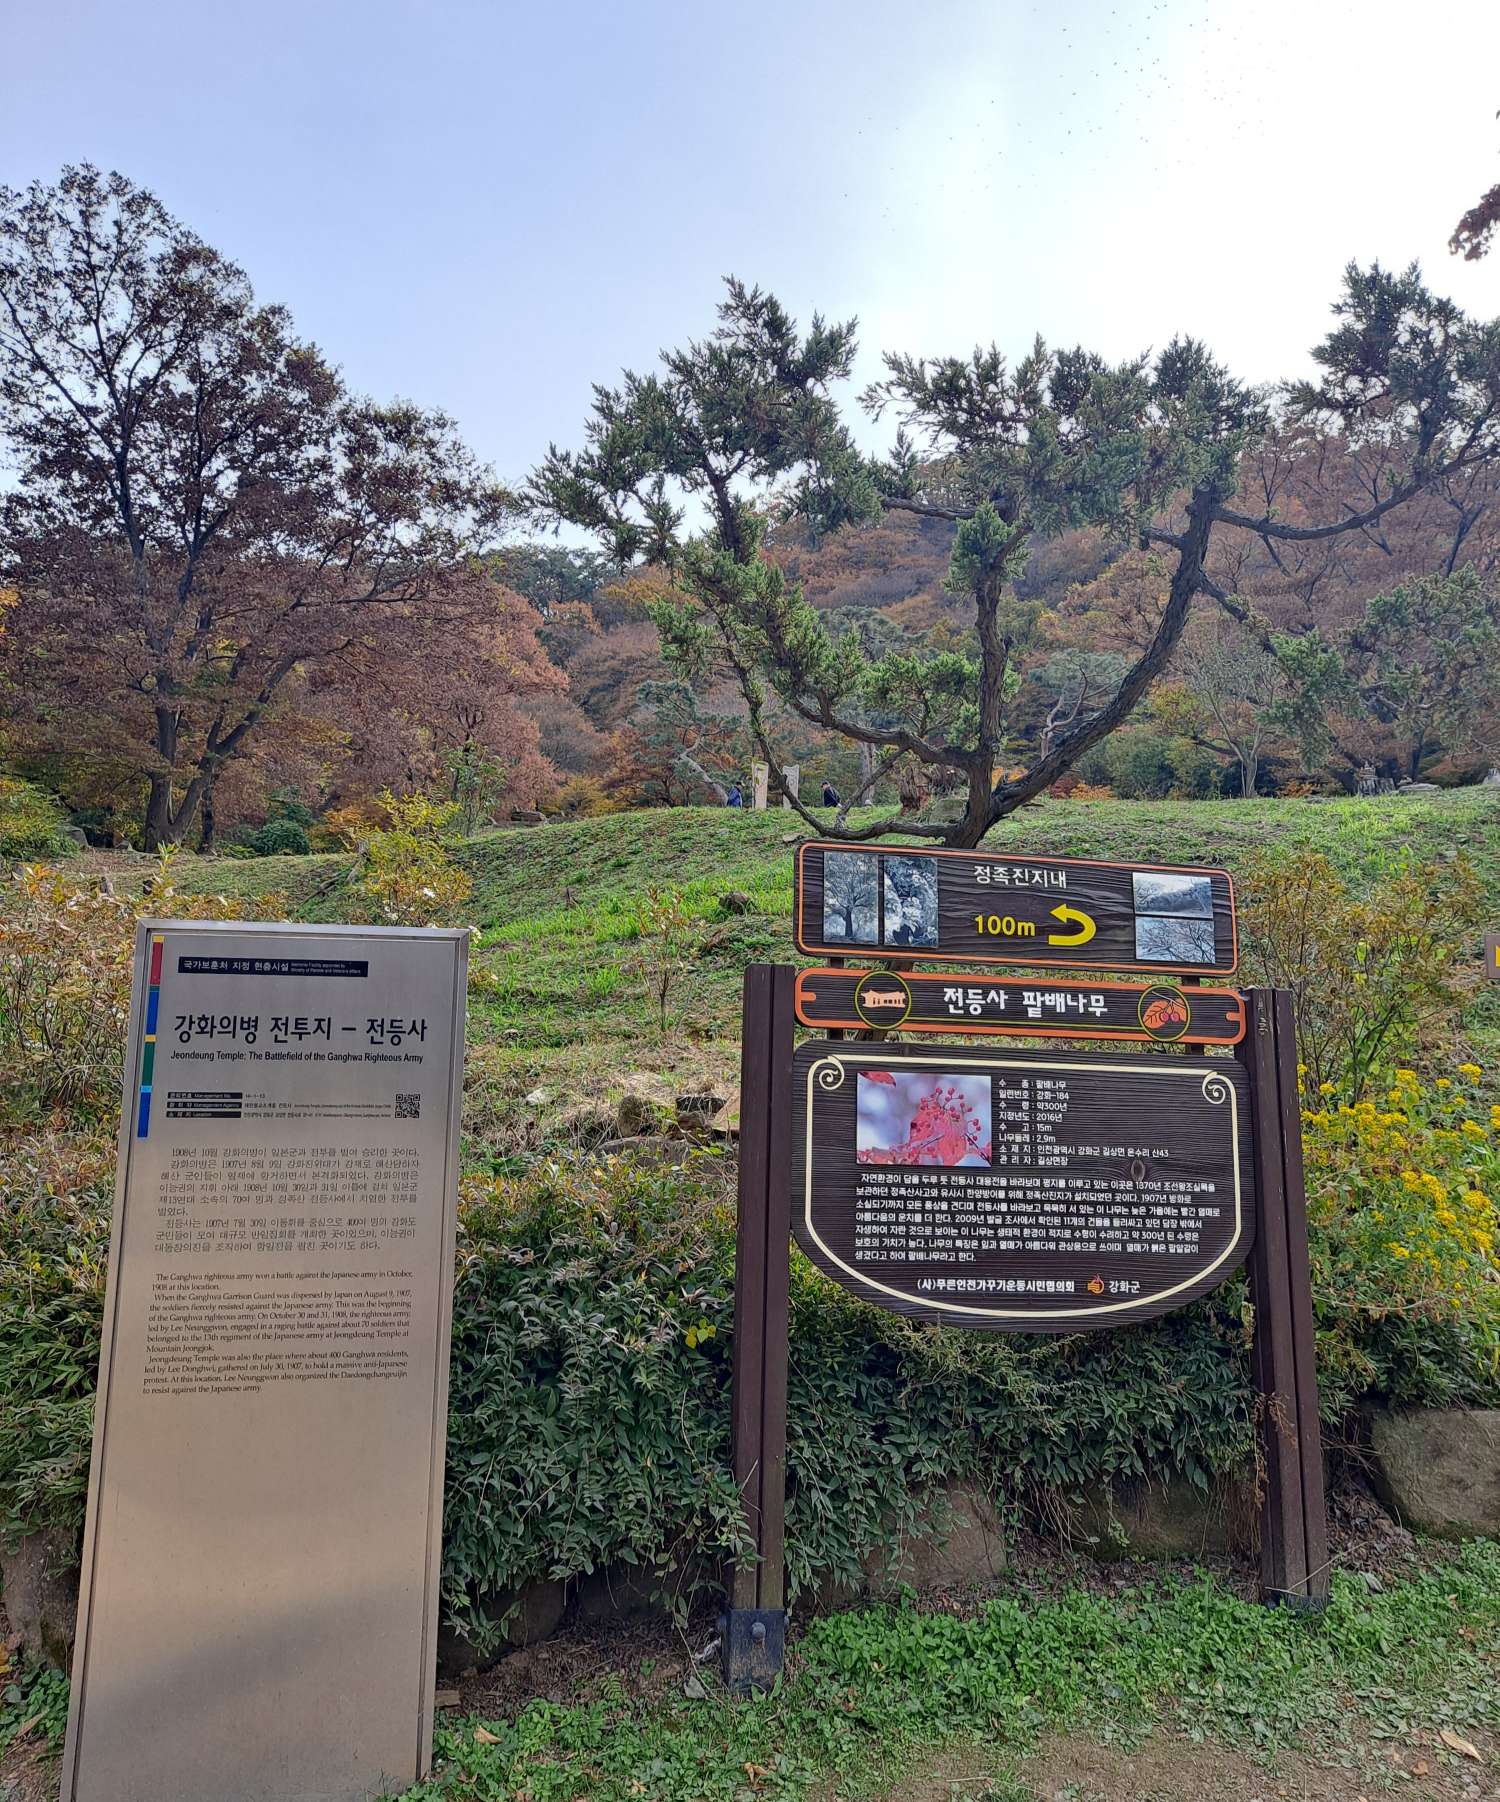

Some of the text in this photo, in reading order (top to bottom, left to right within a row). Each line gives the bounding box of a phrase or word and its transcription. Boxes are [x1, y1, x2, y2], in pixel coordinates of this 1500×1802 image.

[973, 866, 1068, 889] 정족진지내
[974, 915, 1036, 936] 100m
[943, 987, 1109, 1019] 전등사 팥배나무
[174, 1014, 259, 1044] 강화의병
[270, 1016, 331, 1044] 전투지
[366, 1018, 427, 1046] 전등사
[249, 1051, 263, 1060] The
[265, 1051, 303, 1061] Battlefield
[305, 1052, 312, 1061] of
[314, 1052, 325, 1061] the
[327, 1052, 363, 1064] Ganghwa
[364, 1052, 402, 1064] Righteous
[403, 1053, 424, 1065] Army
[1108, 1281, 1141, 1293] 강화군
